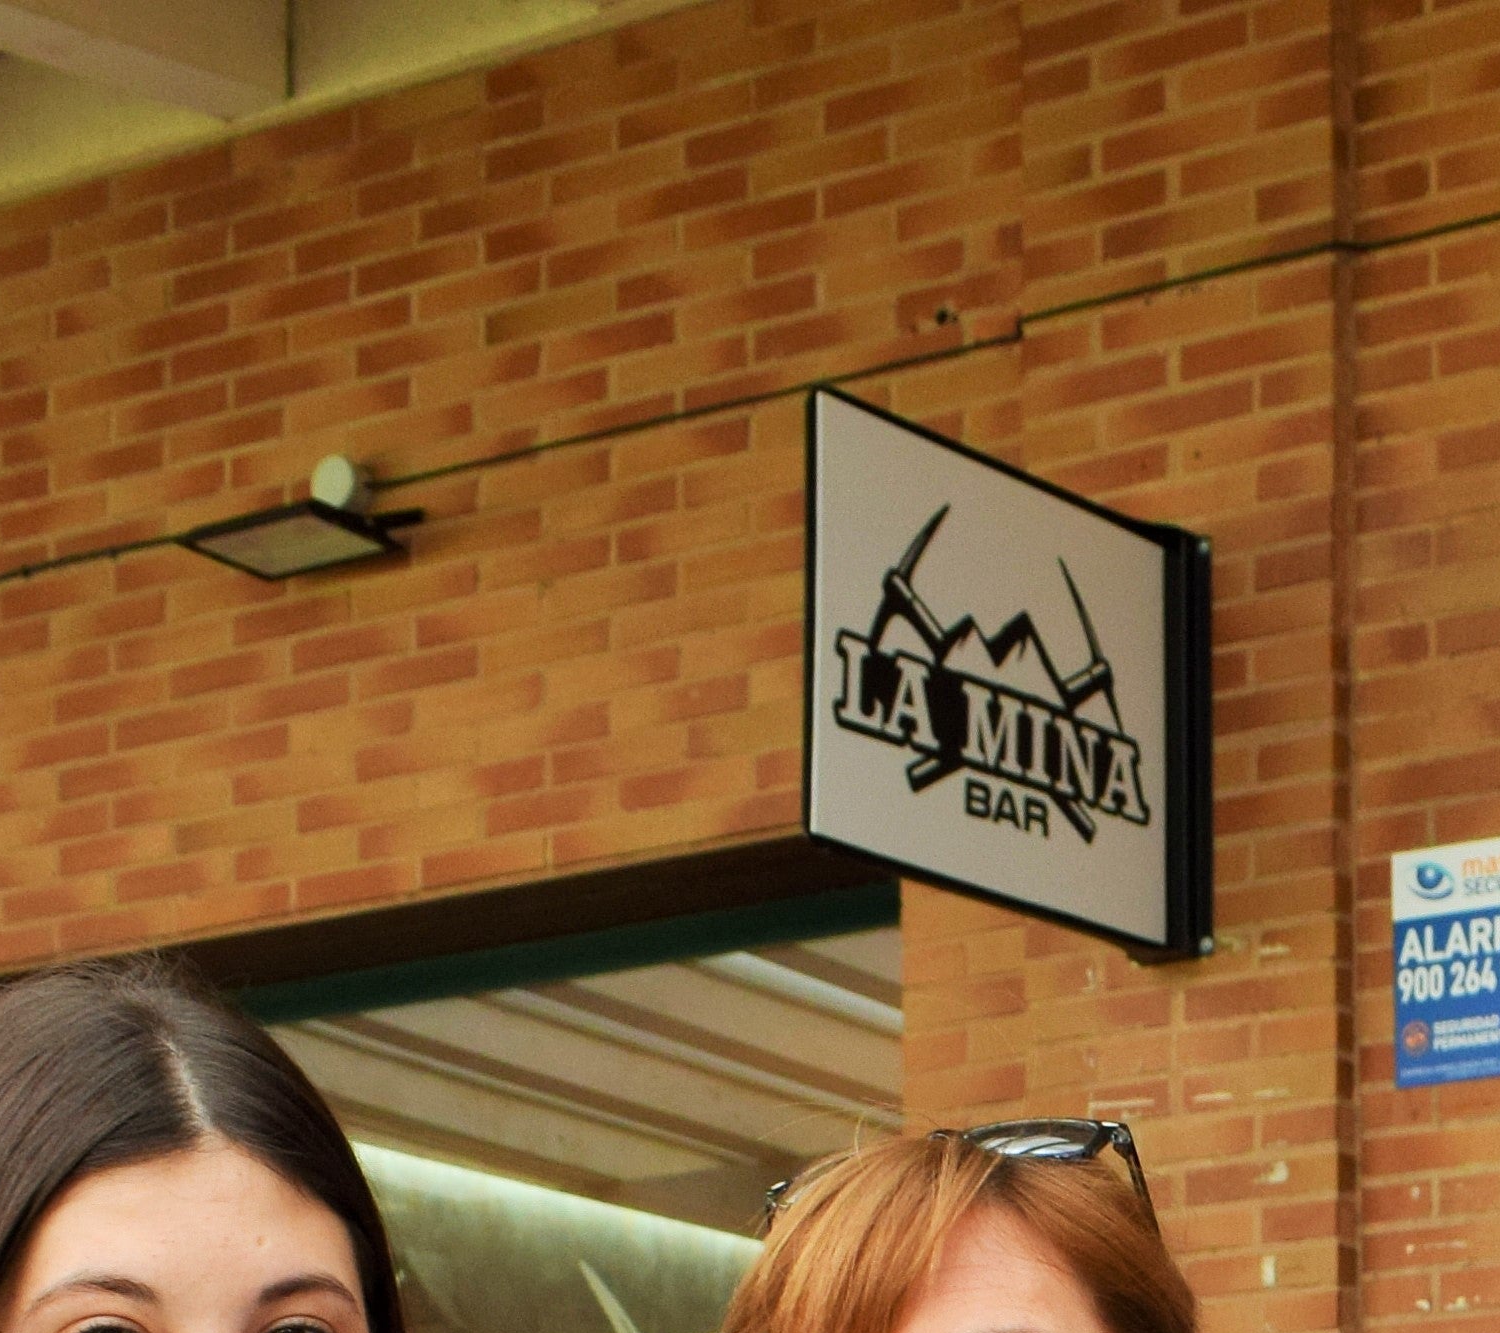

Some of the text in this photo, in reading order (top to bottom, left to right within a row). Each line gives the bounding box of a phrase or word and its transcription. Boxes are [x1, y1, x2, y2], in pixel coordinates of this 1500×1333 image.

[835, 630, 1149, 825] LA MINA
[965, 777, 1048, 837] BAR
[1398, 964, 1445, 1004] 900
[1450, 956, 1498, 996] 264
